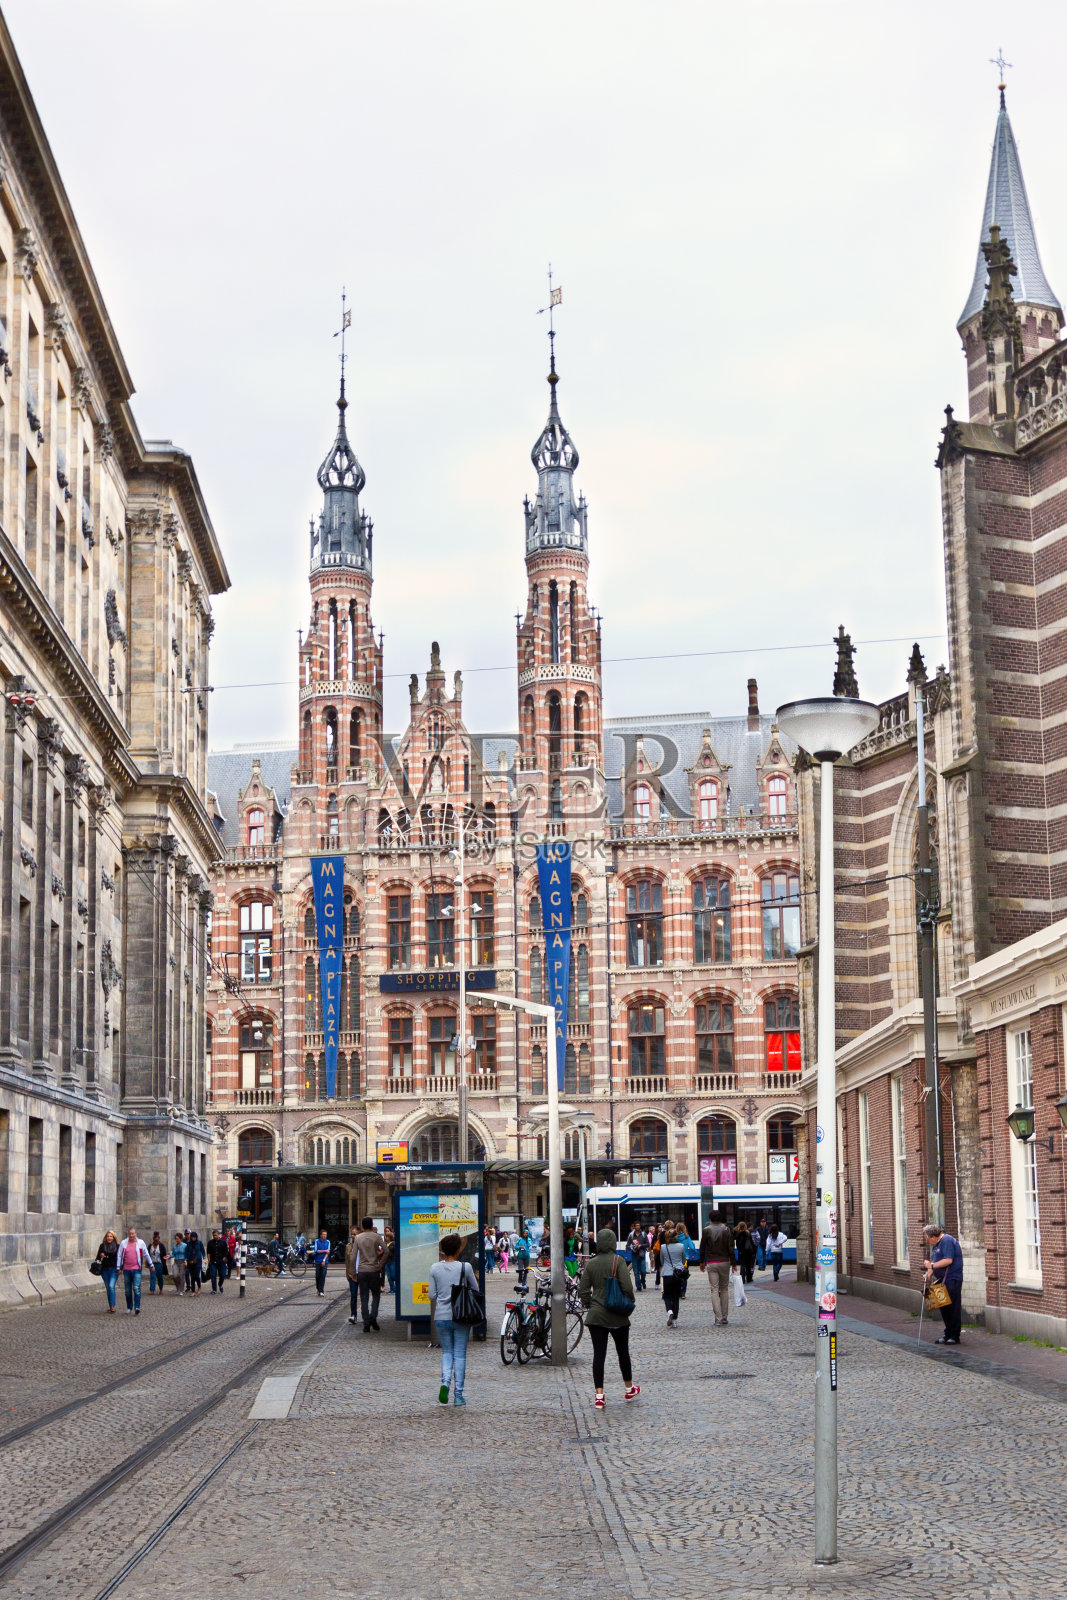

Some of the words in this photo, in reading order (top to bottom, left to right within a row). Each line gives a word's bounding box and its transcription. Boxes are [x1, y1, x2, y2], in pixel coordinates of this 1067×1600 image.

[320, 862, 336, 959] MAGNA
[546, 849, 564, 948] MAGNA
[327, 971, 336, 1047] PLAZA
[554, 961, 564, 1039] PLAZA
[990, 983, 1037, 1015] MUSEUMWINKEL
[699, 1158, 736, 1172] SALE
